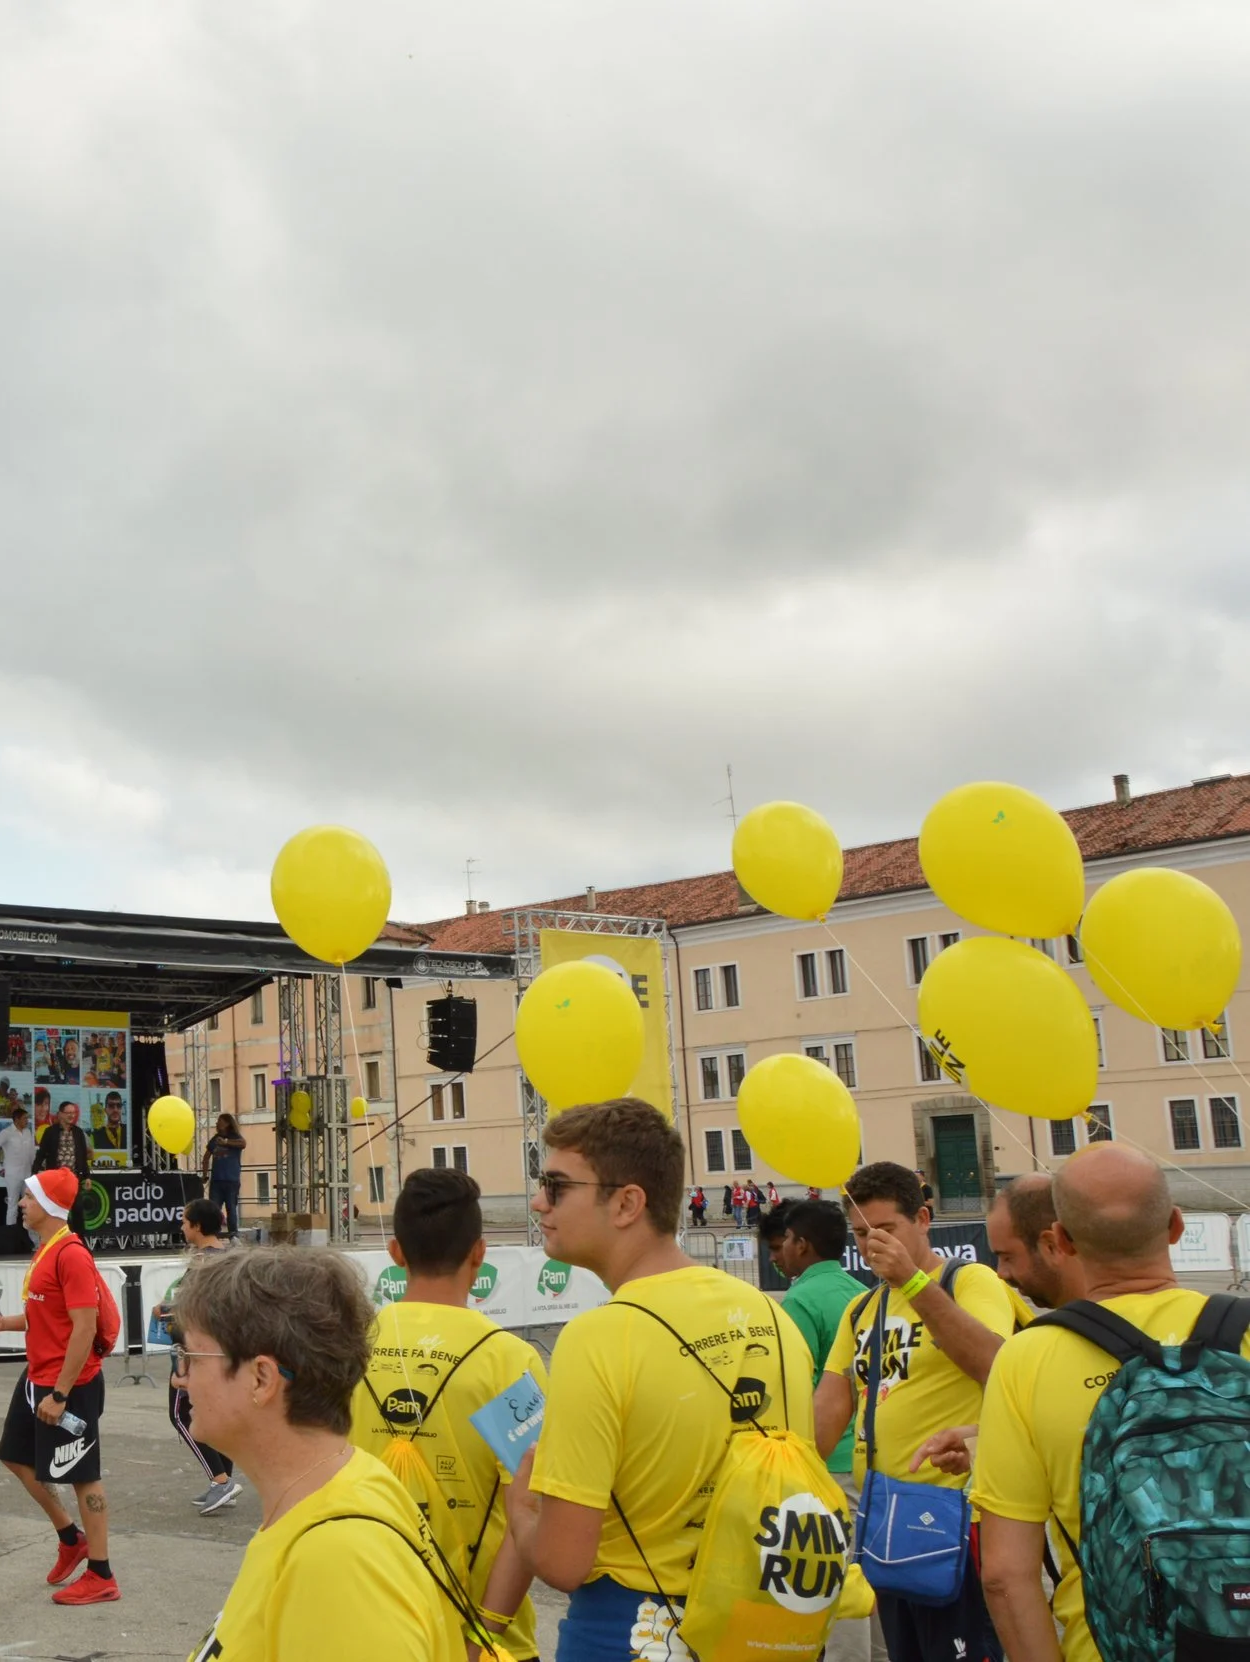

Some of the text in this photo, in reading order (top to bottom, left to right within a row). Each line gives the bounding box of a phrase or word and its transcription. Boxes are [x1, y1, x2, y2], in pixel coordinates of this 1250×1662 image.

[115, 1180, 164, 1201] radio
[115, 1203, 185, 1228] padova
[543, 1268, 566, 1285] Pam
[729, 1328, 745, 1342] FA
[748, 1326, 775, 1338] BENE
[372, 1347, 461, 1366] RRERE FA BENE
[387, 1396, 421, 1414] Pam
[732, 1390, 761, 1408] am
[55, 1436, 86, 1465] NIKE
